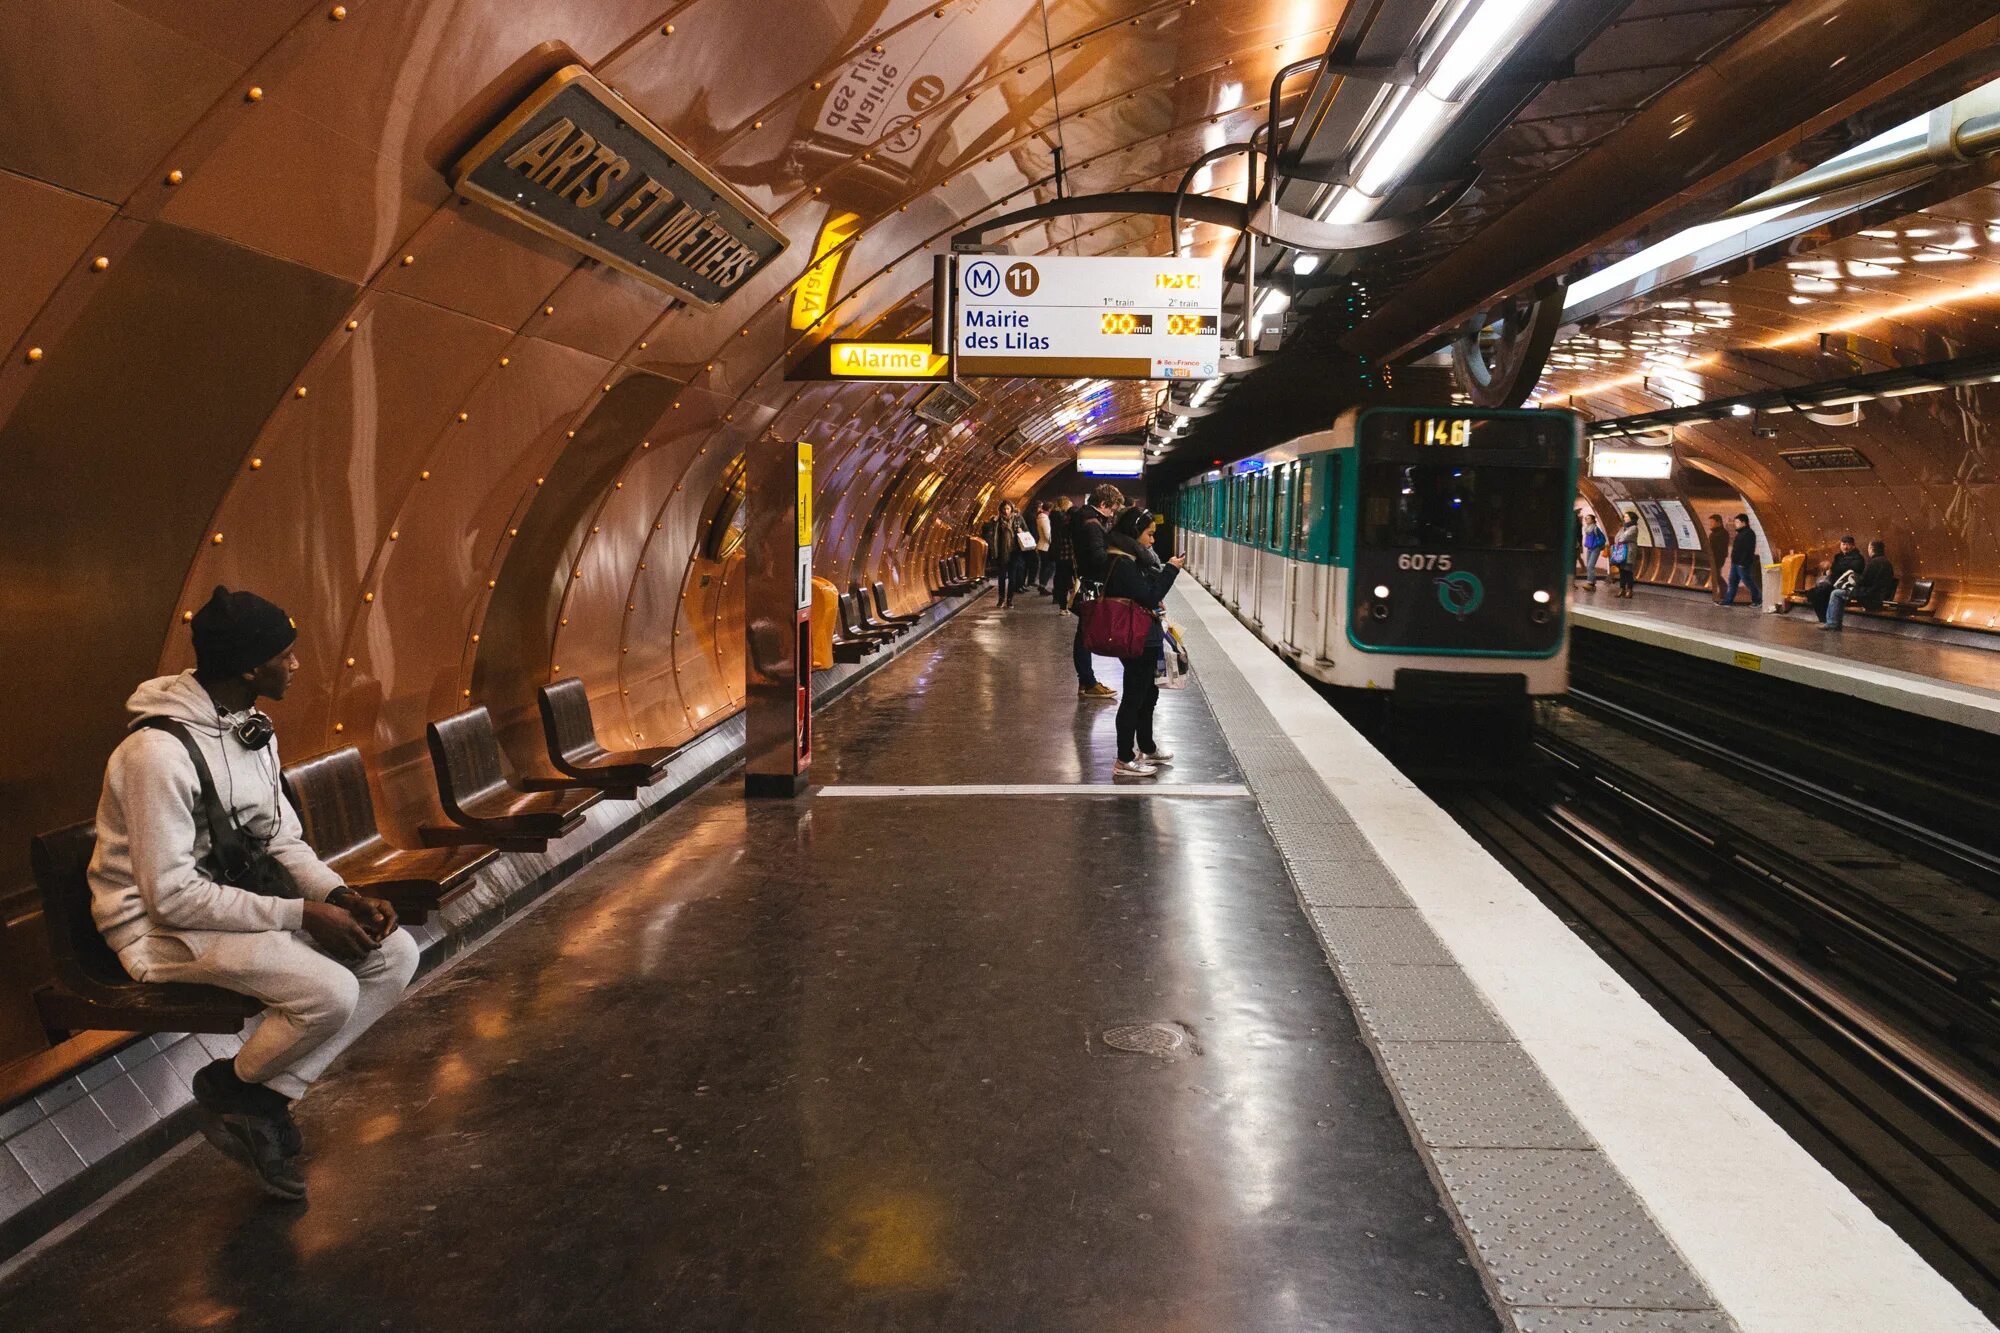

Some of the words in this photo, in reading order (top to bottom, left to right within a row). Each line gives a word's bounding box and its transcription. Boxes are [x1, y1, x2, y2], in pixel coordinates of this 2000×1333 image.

[504, 117, 631, 208] ARTS
[606, 175, 675, 233] ET
[645, 200, 760, 288] MÉTIERS
[1009, 268, 1032, 290] 11
[1115, 299, 1135, 307] train
[1180, 300, 1199, 308] train
[966, 310, 1029, 328] Mairie
[1102, 313, 1135, 335] 00
[1134, 325, 1152, 334] min
[1168, 314, 1201, 335] 03
[1200, 326, 1217, 335] min
[965, 332, 998, 349] des
[1005, 332, 1050, 350] Lilas
[846, 349, 921, 368] Alarme
[1398, 553, 1452, 570] 6075
